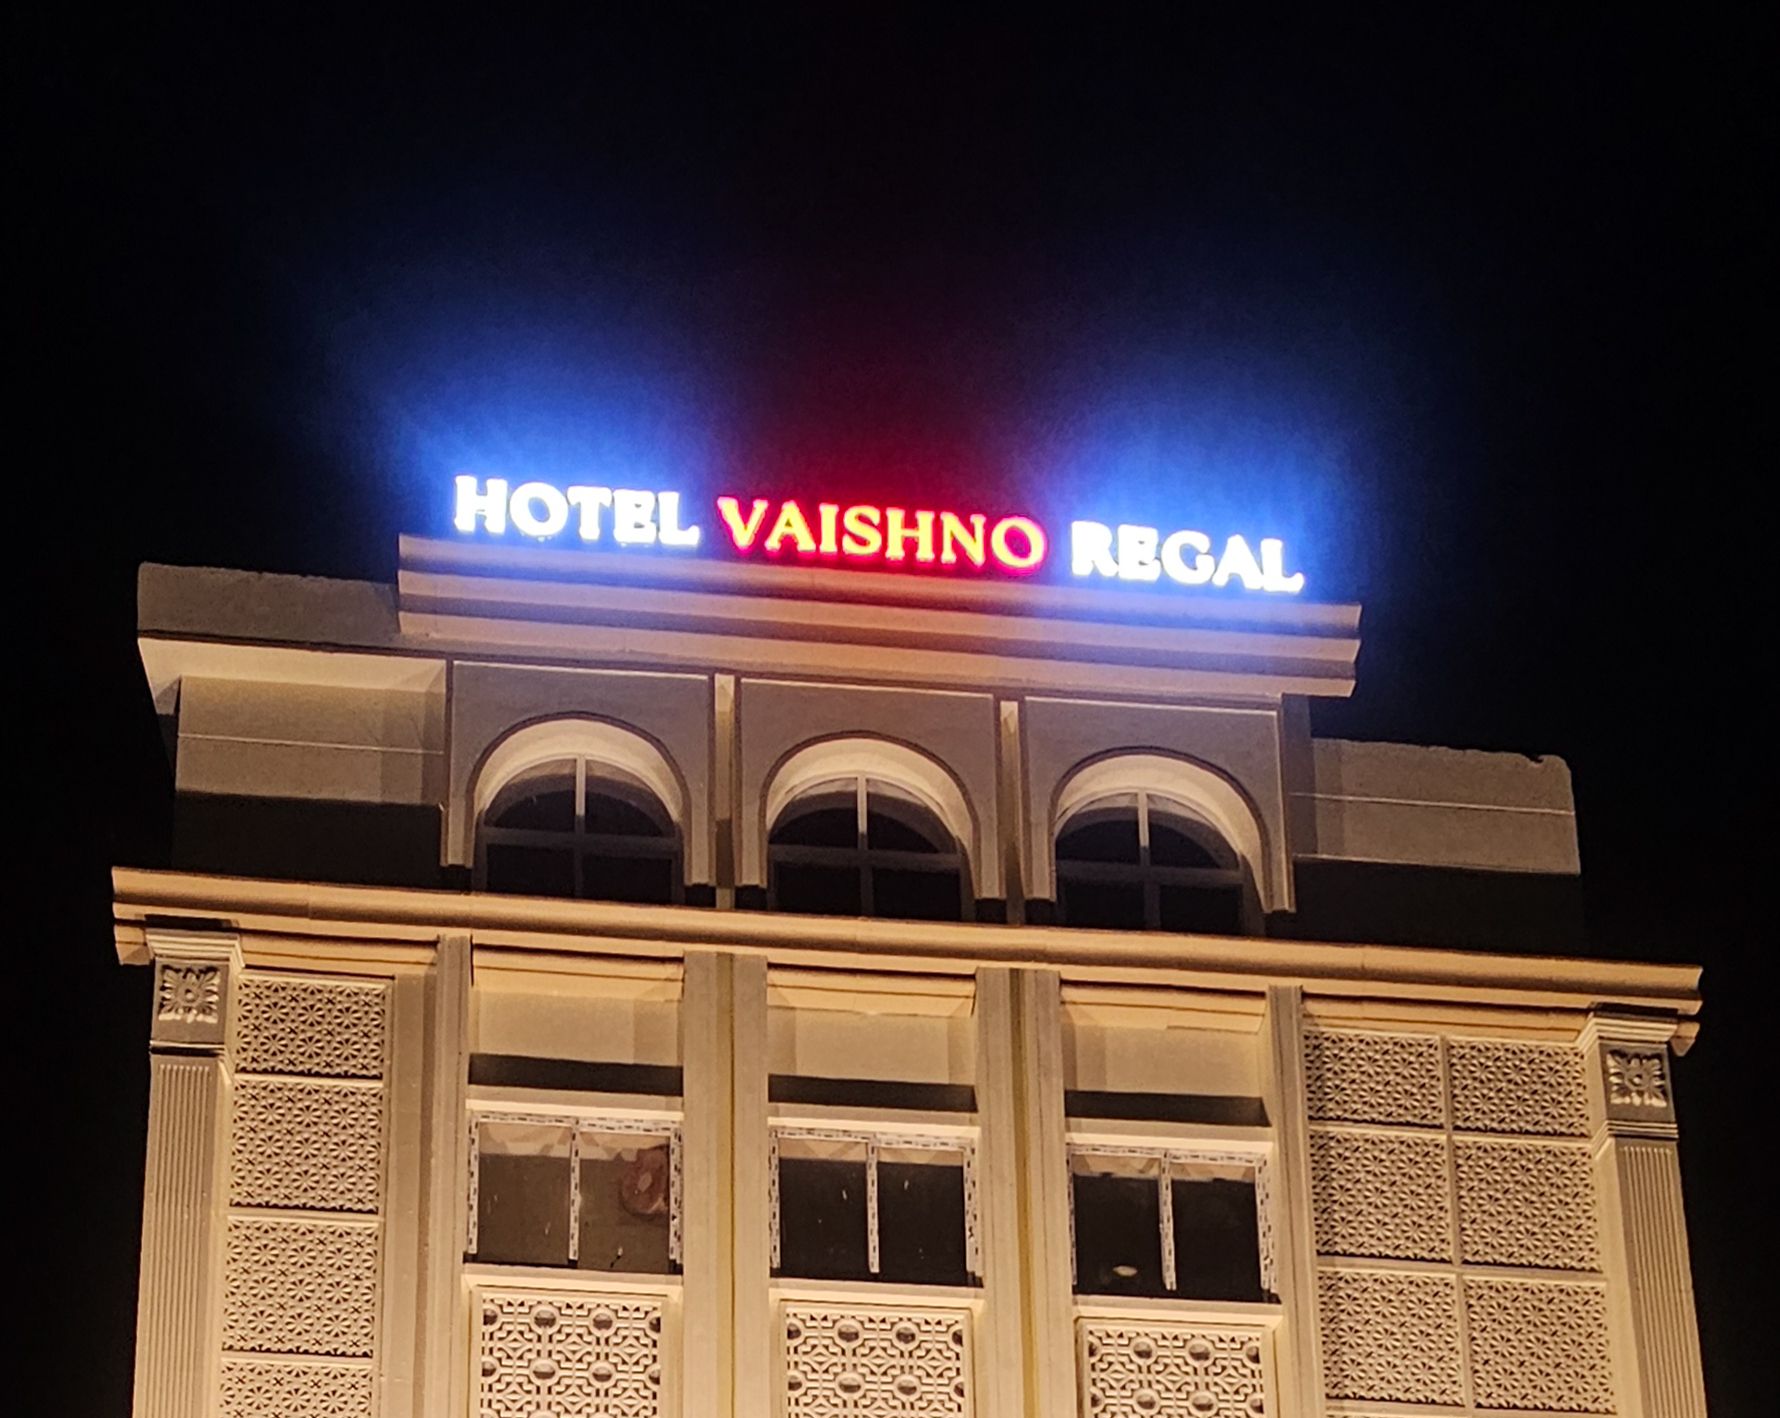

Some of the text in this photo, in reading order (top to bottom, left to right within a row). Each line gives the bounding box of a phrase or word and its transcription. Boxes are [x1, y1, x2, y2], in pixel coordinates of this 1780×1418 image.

[453, 475, 1305, 592] HOTEL VAISHNO REGAL
